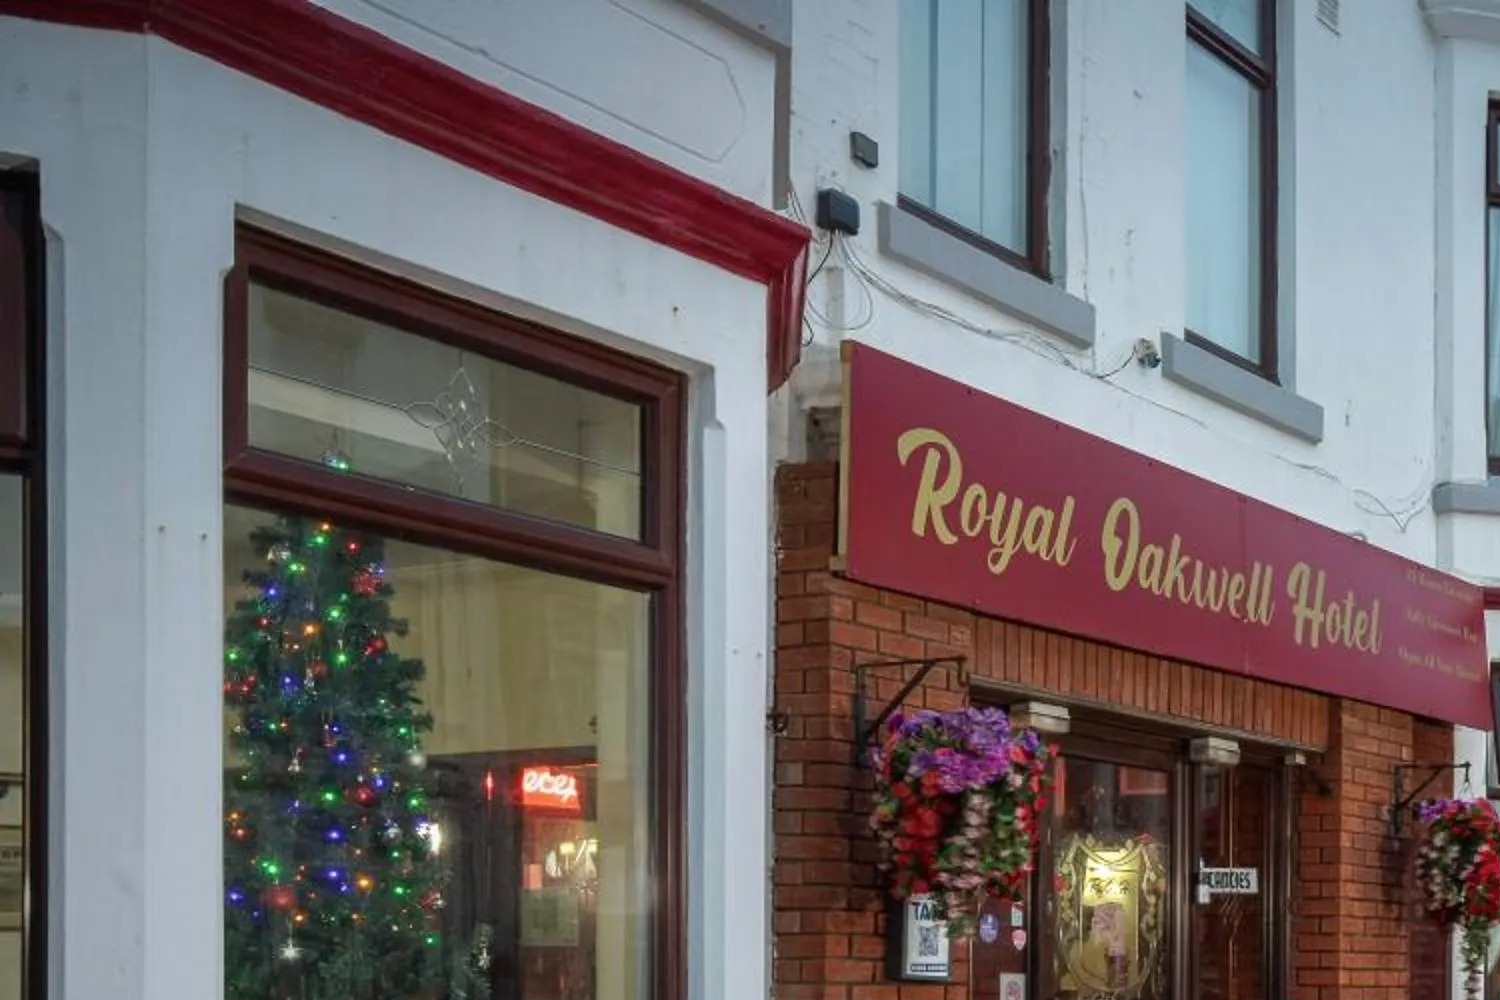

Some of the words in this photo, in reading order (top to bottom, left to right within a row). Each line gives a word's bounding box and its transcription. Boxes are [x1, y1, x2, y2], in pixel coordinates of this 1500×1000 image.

[898, 427, 1077, 575] Royal
[1102, 497, 1275, 626] Oakwell
[1287, 561, 1382, 655] Hotel
